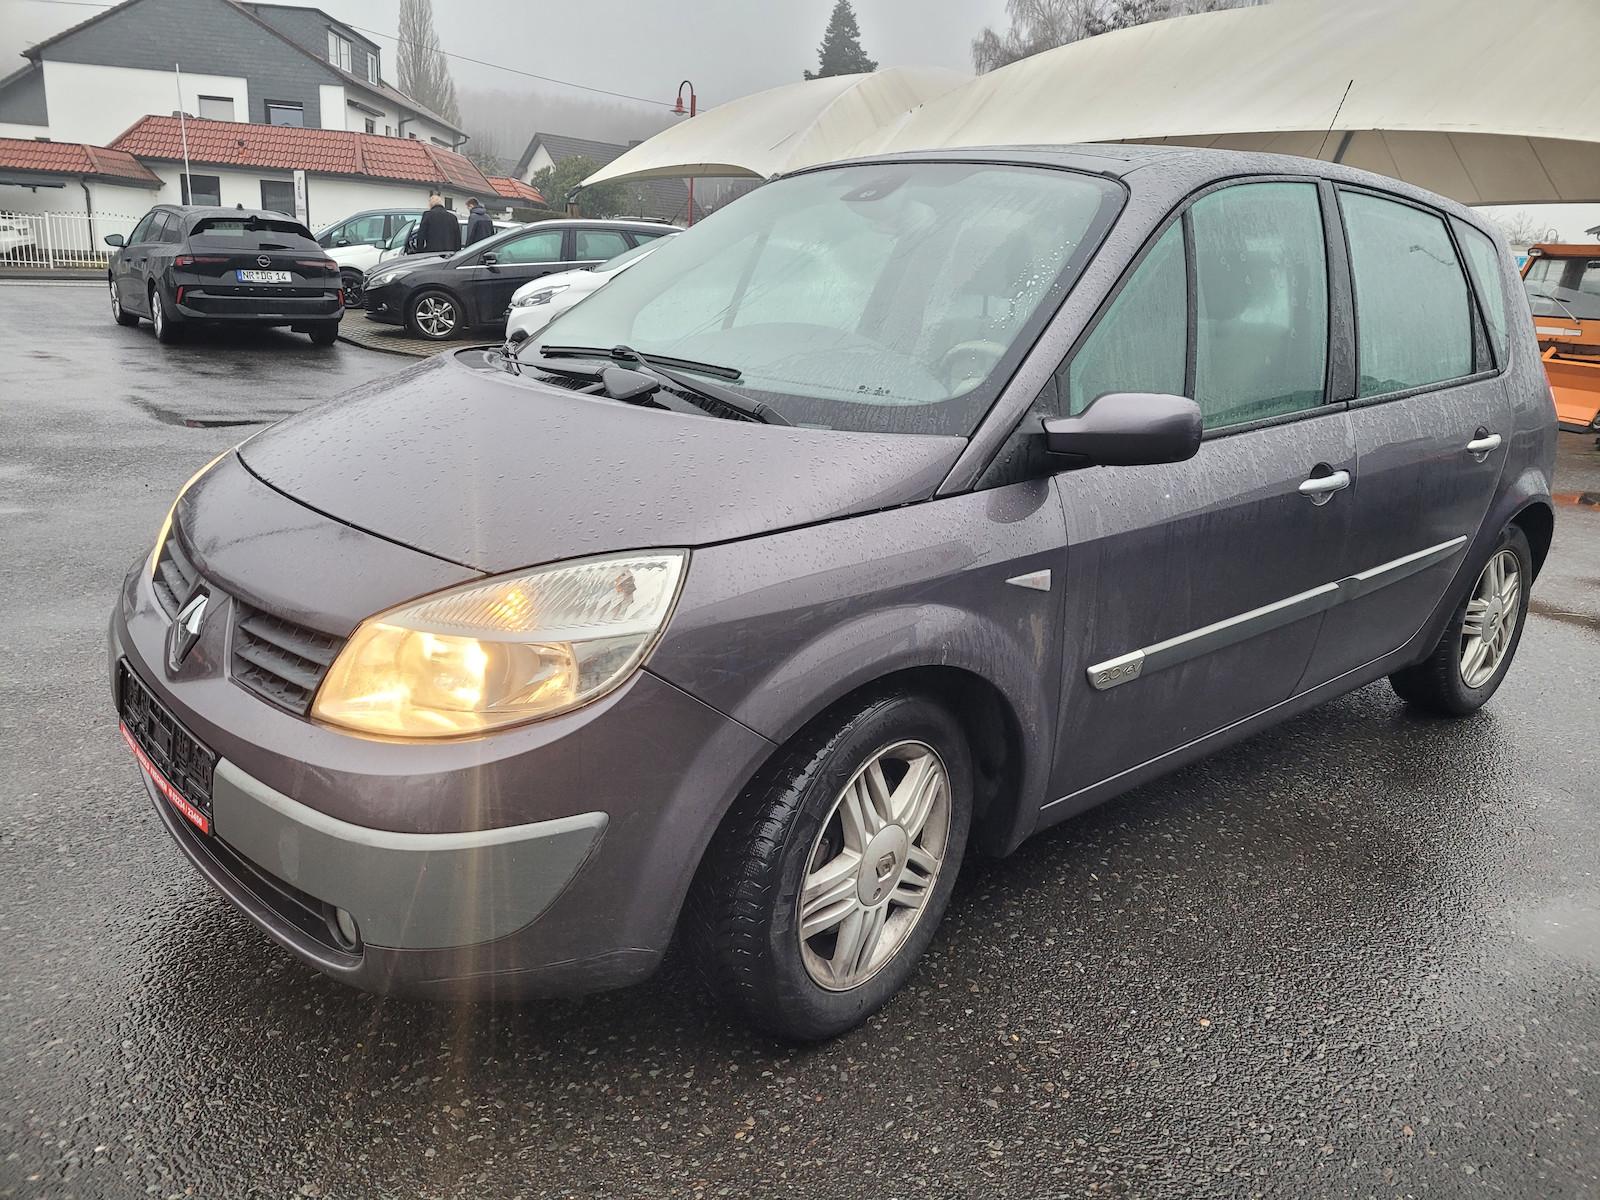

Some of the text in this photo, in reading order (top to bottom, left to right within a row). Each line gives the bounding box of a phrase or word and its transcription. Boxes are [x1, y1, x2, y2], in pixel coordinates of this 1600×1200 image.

[242, 271, 287, 281] NR DG 14
